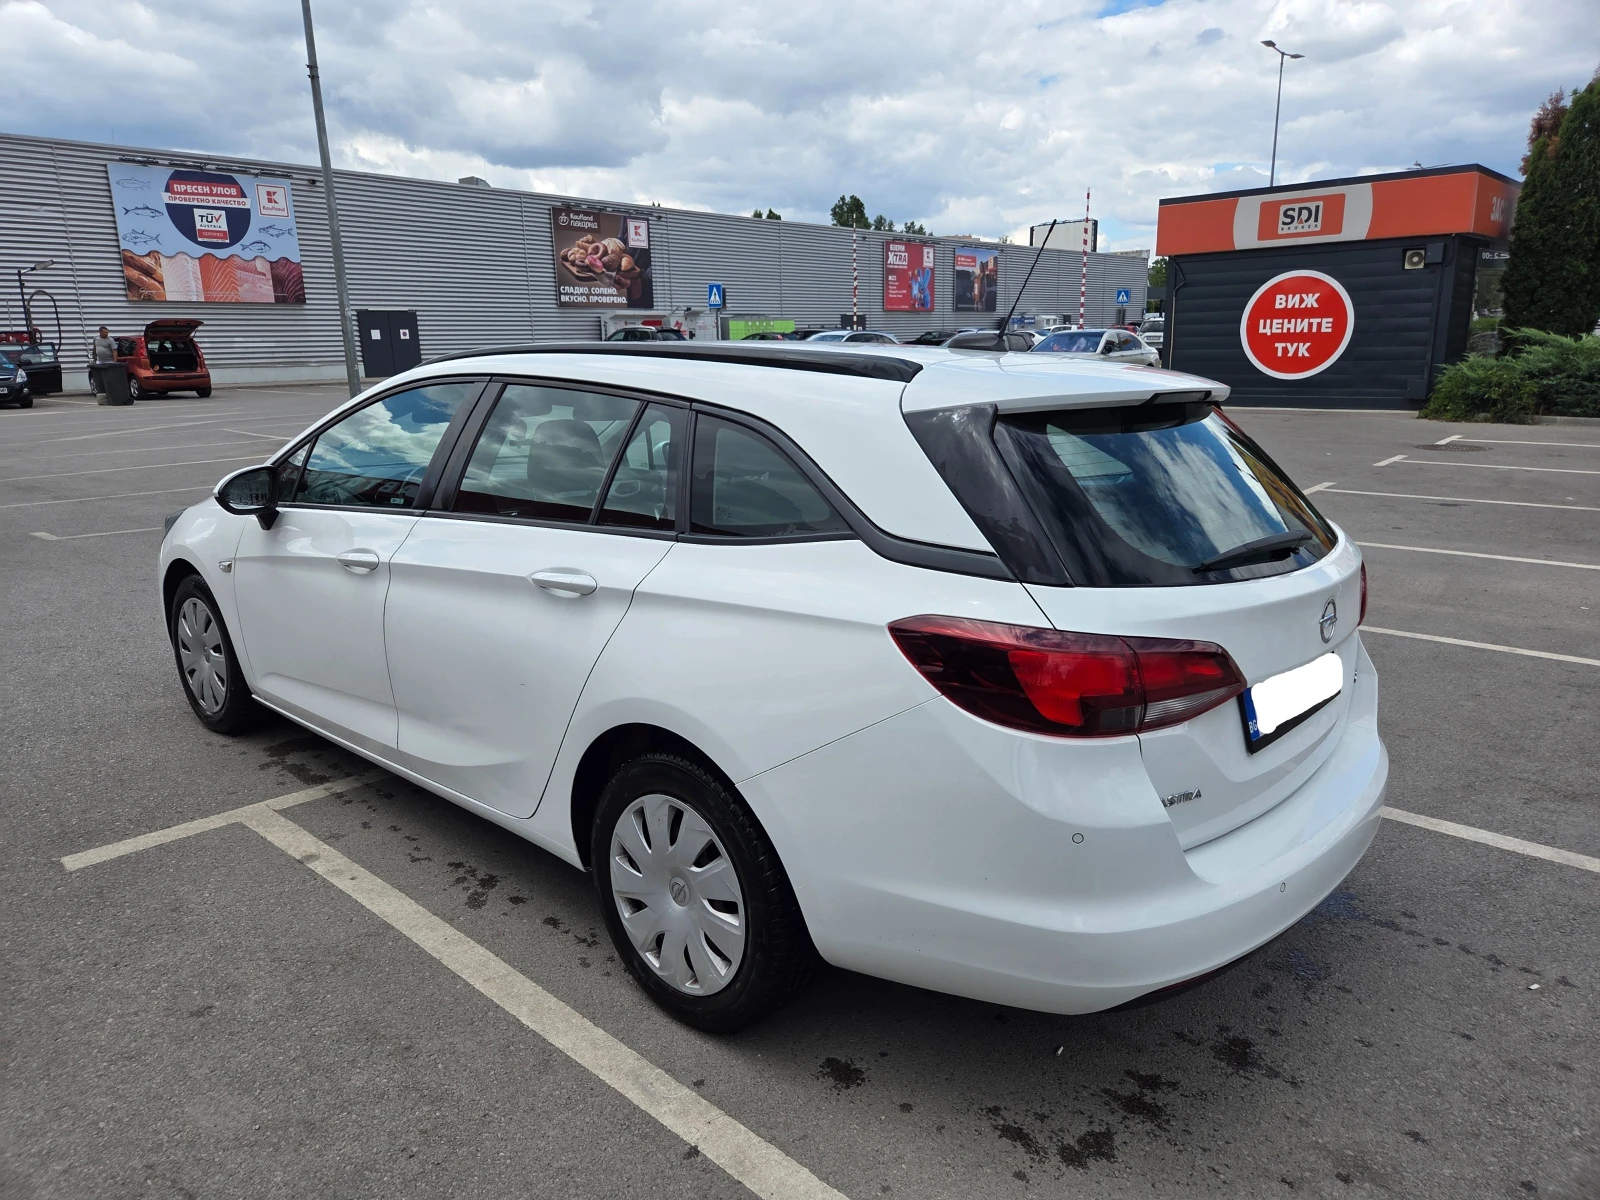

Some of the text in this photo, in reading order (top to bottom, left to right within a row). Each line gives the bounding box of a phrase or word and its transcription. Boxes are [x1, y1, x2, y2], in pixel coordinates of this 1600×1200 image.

[173, 183, 237, 196] ПРЕСЕН УЛОВ
[168, 195, 246, 206] ПРОВЕРЕНО КАЧЕСТВО
[198, 212, 222, 223] TÜV
[569, 212, 593, 221] Kaufland
[1281, 204, 1320, 226] SDI
[1280, 223, 1318, 231] BROKER
[560, 286, 618, 295] СЛАДКО. СОЛЕНО.
[560, 295, 628, 304] ВКУСНО. ПРОВЕРЕНО.
[1274, 293, 1320, 309] ВИЖ
[1258, 318, 1333, 336] ЦЕНИТЕ
[1274, 342, 1312, 357] ТУК
[1248, 719, 1258, 734] BG
